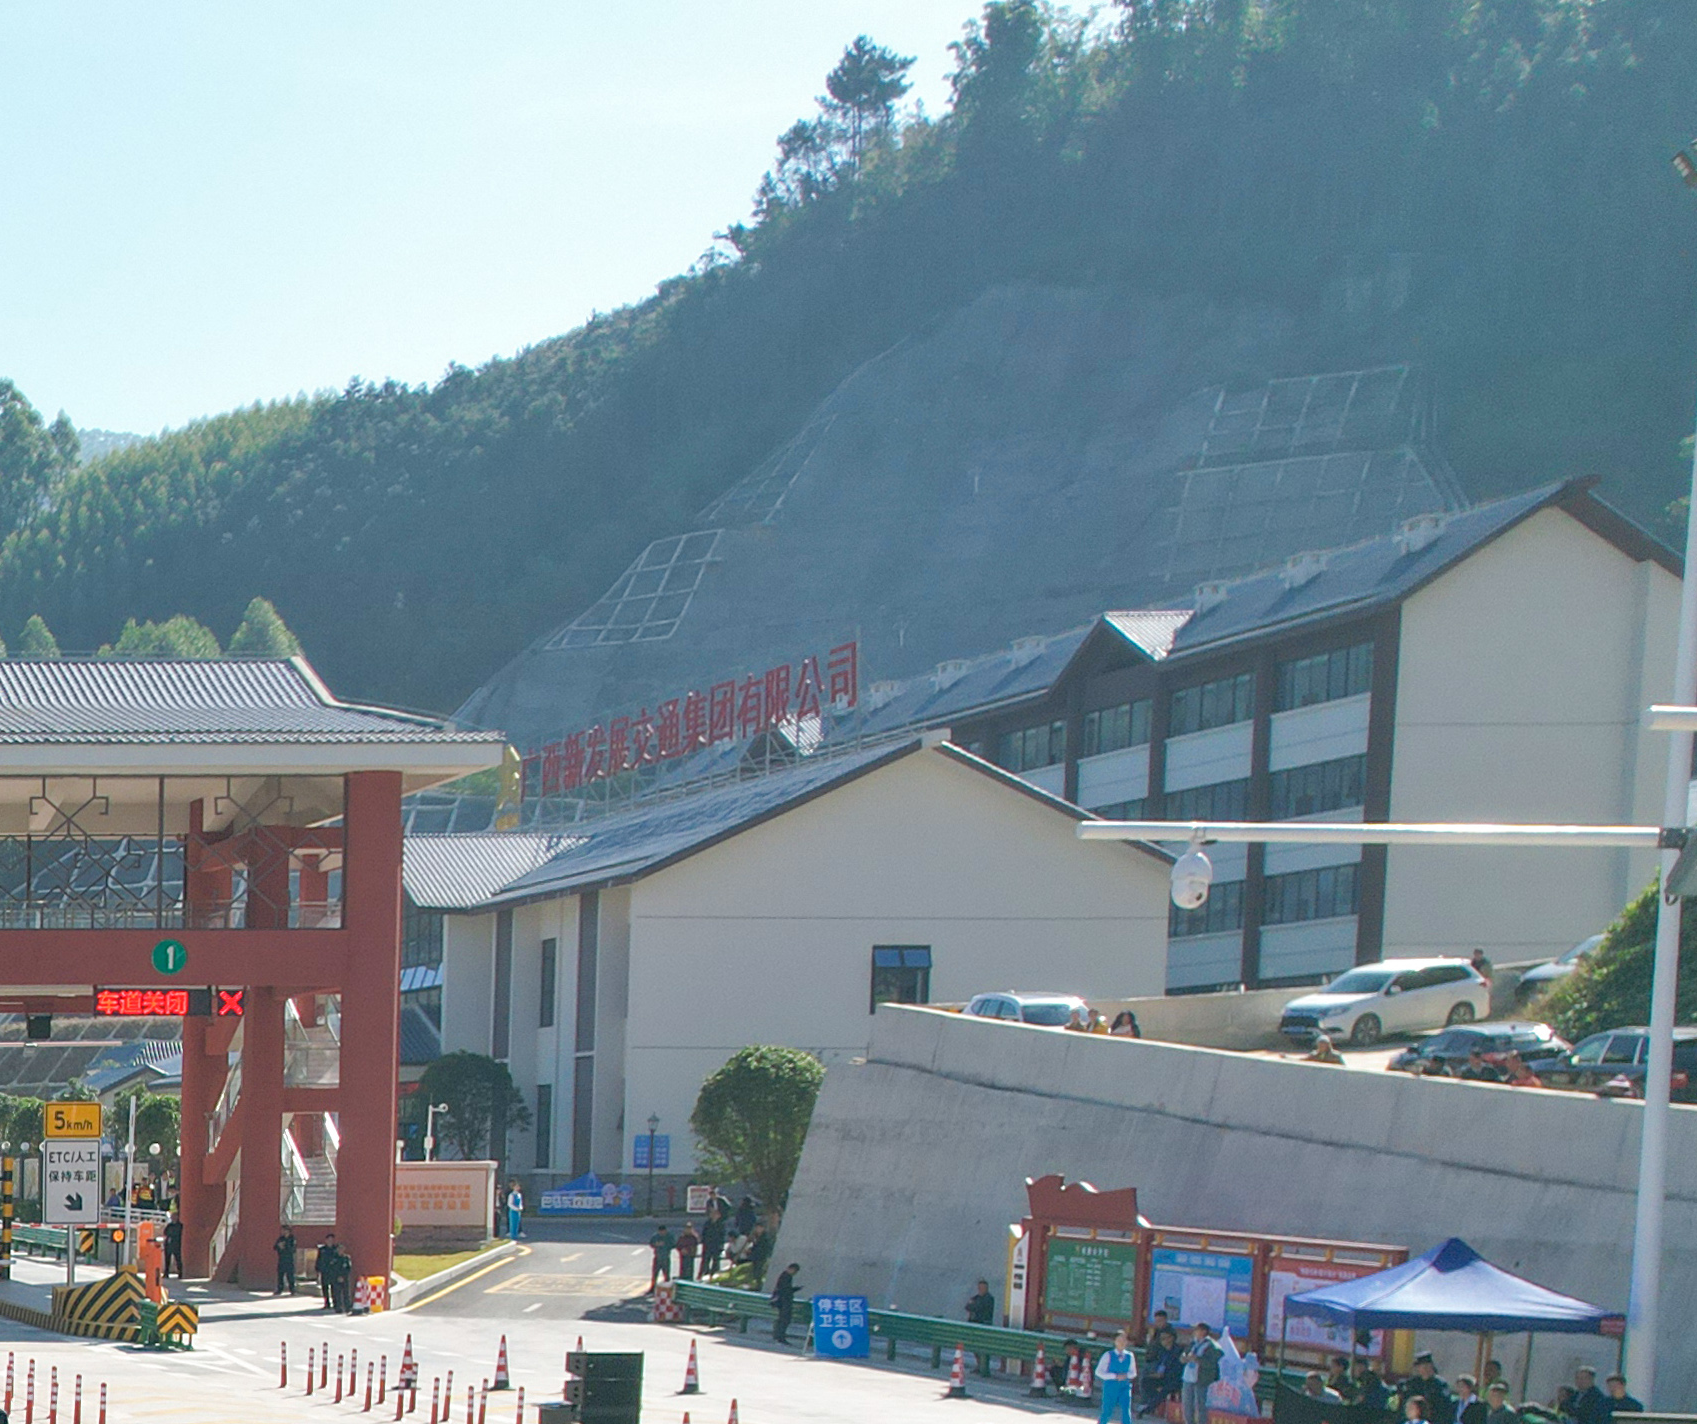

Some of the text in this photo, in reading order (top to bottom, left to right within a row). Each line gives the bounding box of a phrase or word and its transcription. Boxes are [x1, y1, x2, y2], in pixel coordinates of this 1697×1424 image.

[166, 945, 175, 969] 1
[49, 1151, 96, 1163] ETC/人工
[48, 1170, 96, 1182] 保持车距
[818, 1298, 863, 1313] 停车区
[818, 1313, 864, 1328] 卫生间
